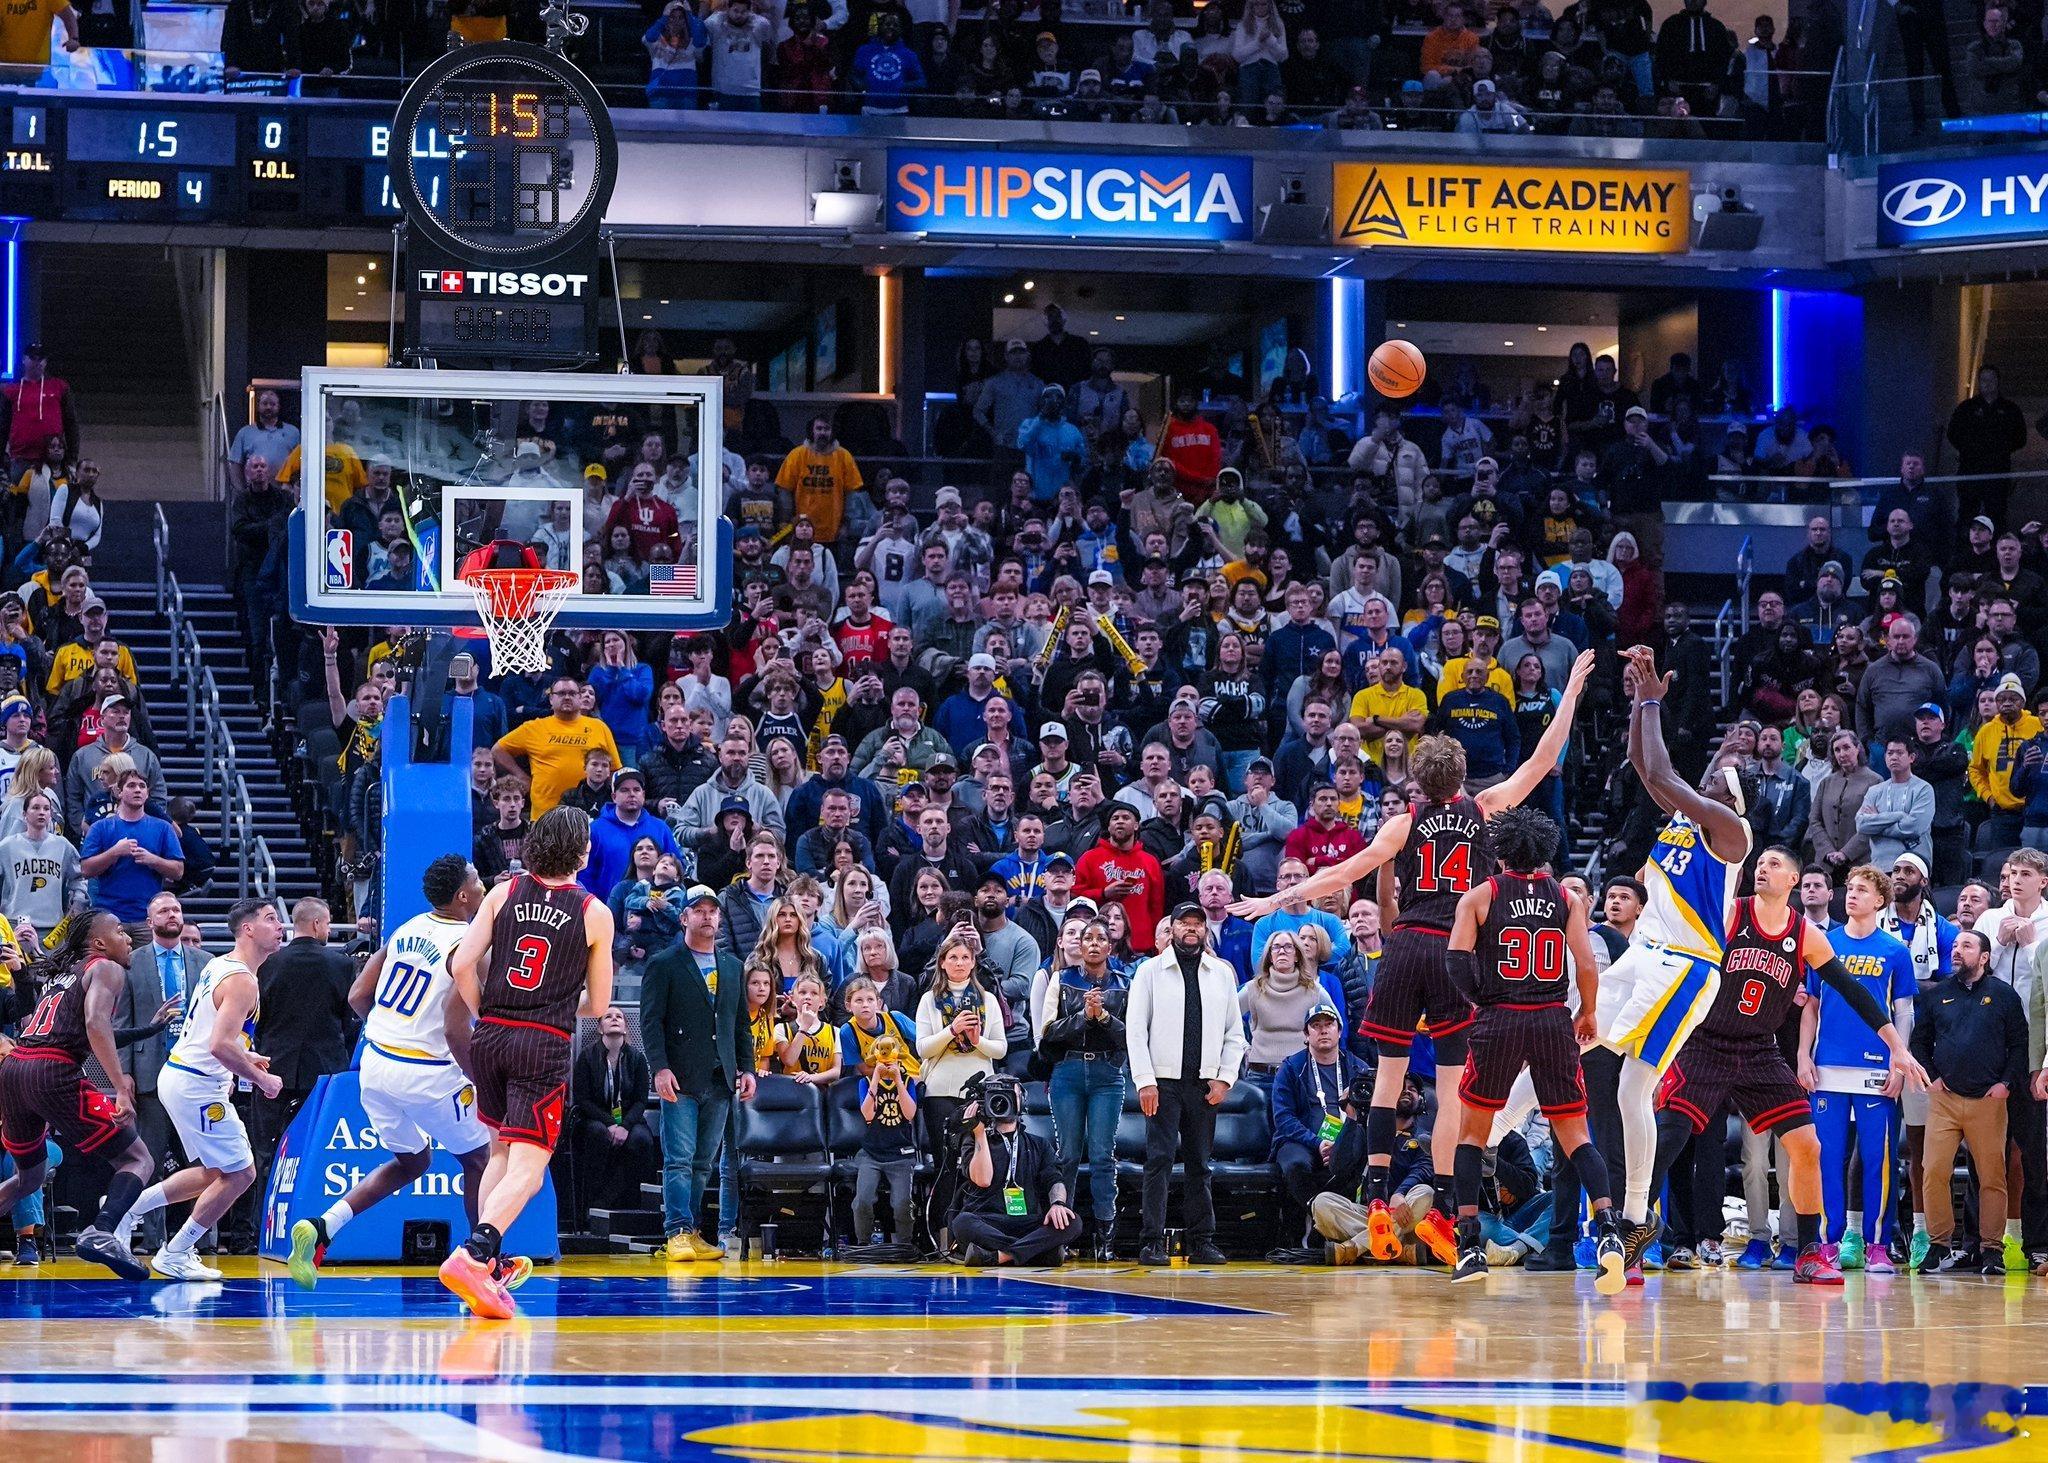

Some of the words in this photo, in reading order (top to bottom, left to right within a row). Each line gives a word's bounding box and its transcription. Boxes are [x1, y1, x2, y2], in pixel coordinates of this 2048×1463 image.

[28, 115, 37, 138] 1
[489, 93, 539, 138] 1.5
[138, 121, 178, 157] 1.5
[264, 122, 282, 149] 0
[372, 126, 468, 160] BLLS
[7, 152, 50, 171] T.O.L.
[253, 160, 296, 179] T.O.L.
[108, 179, 161, 199] PERIOD
[186, 180, 202, 203] 4
[381, 175, 440, 208] 11
[895, 162, 1244, 224] SHIPSIGMA
[1406, 176, 1482, 209] LIFT
[1491, 179, 1676, 213] ACADEMY
[1418, 215, 1516, 235] FLIGHT
[1532, 217, 1671, 238] TRAINING
[466, 271, 588, 297] TISSOT
[329, 574, 343, 585] NBA
[1517, 700, 1547, 713] INDY
[549, 735, 588, 745] PACERS
[763, 725, 798, 737] BUTLER
[1417, 813, 1480, 839] BUZELIS
[14, 858, 61, 880] PACERS
[1416, 839, 1473, 894] 14
[1660, 847, 1693, 876] 43
[514, 902, 572, 931] GIDDEY
[1509, 898, 1556, 919] JONES
[396, 935, 442, 967] MATHURIN
[506, 933, 552, 992] 3
[1497, 927, 1566, 982] 30
[1726, 947, 1793, 989] CHICAGO
[378, 960, 433, 1018] 00
[1738, 978, 1766, 1017] 9
[20, 990, 66, 1038] 11
[882, 1102, 898, 1117] 43
